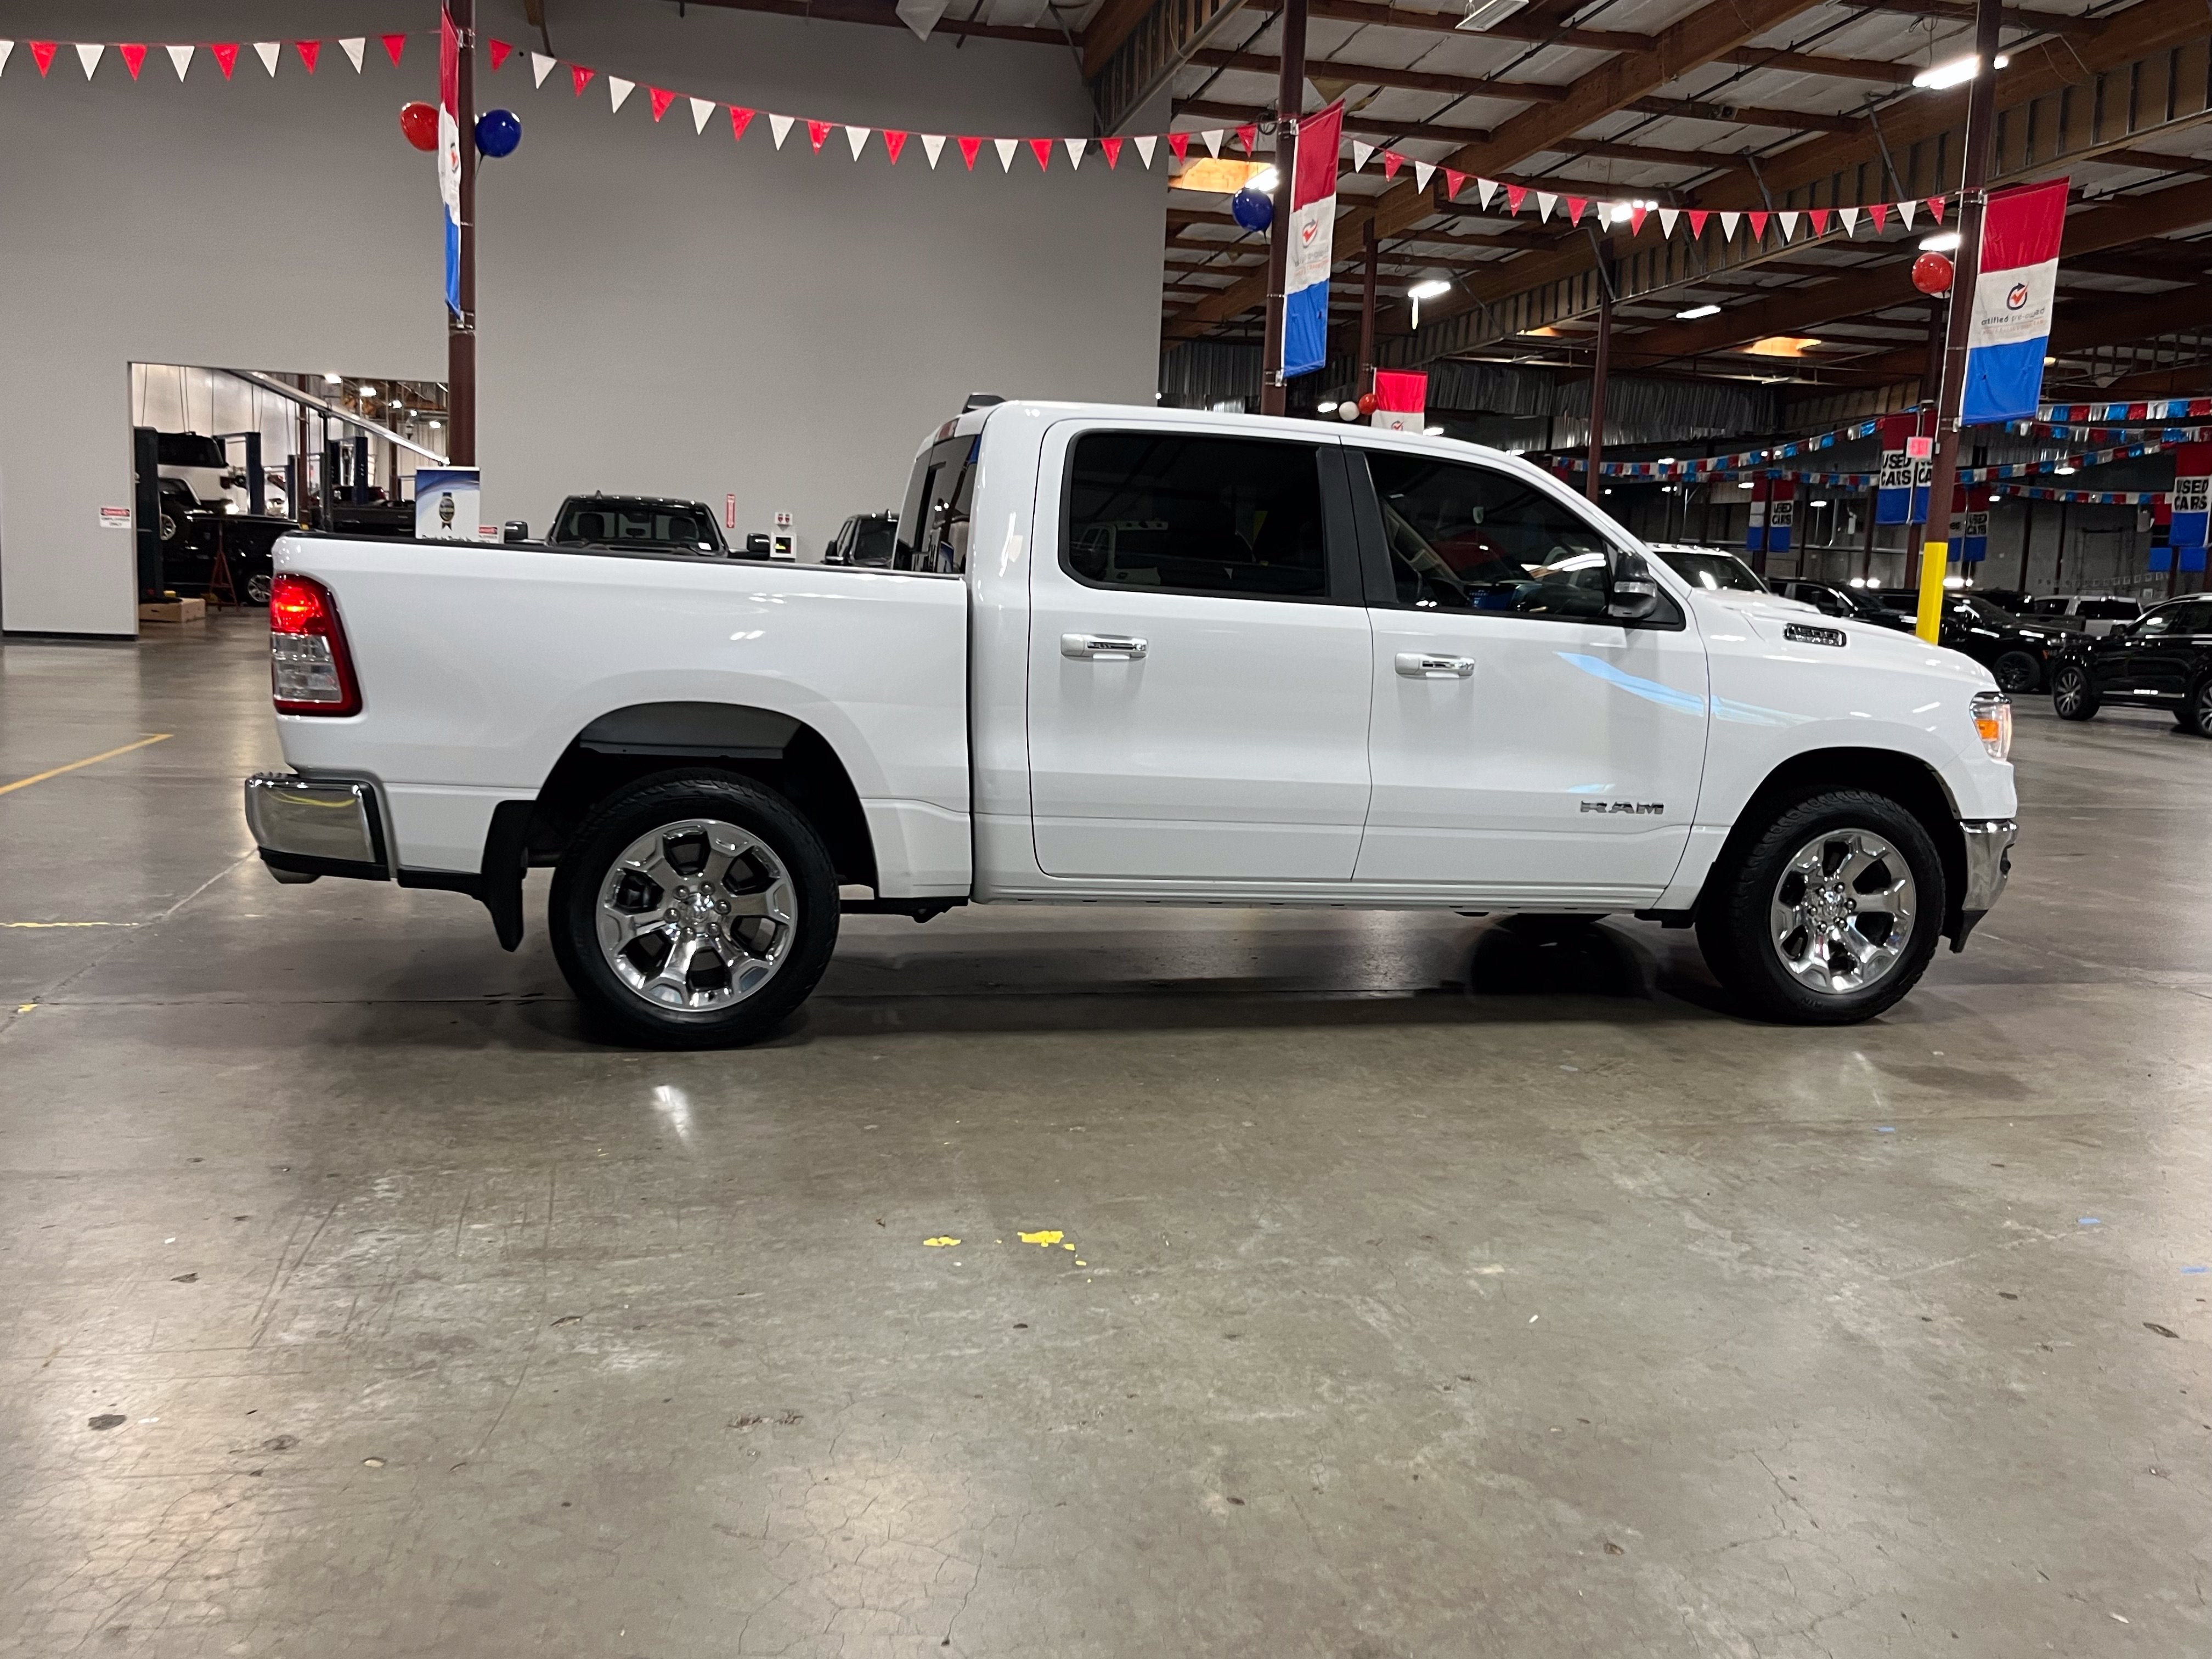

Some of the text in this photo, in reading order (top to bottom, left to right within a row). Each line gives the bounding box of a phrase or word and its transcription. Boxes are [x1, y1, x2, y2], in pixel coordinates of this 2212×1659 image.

[1882, 454, 1911, 469] USED
[1881, 470, 1911, 486] CARS
[2176, 478, 2209, 494] USED
[2174, 496, 2208, 511] CARS
[1580, 801, 1664, 815] RAM
